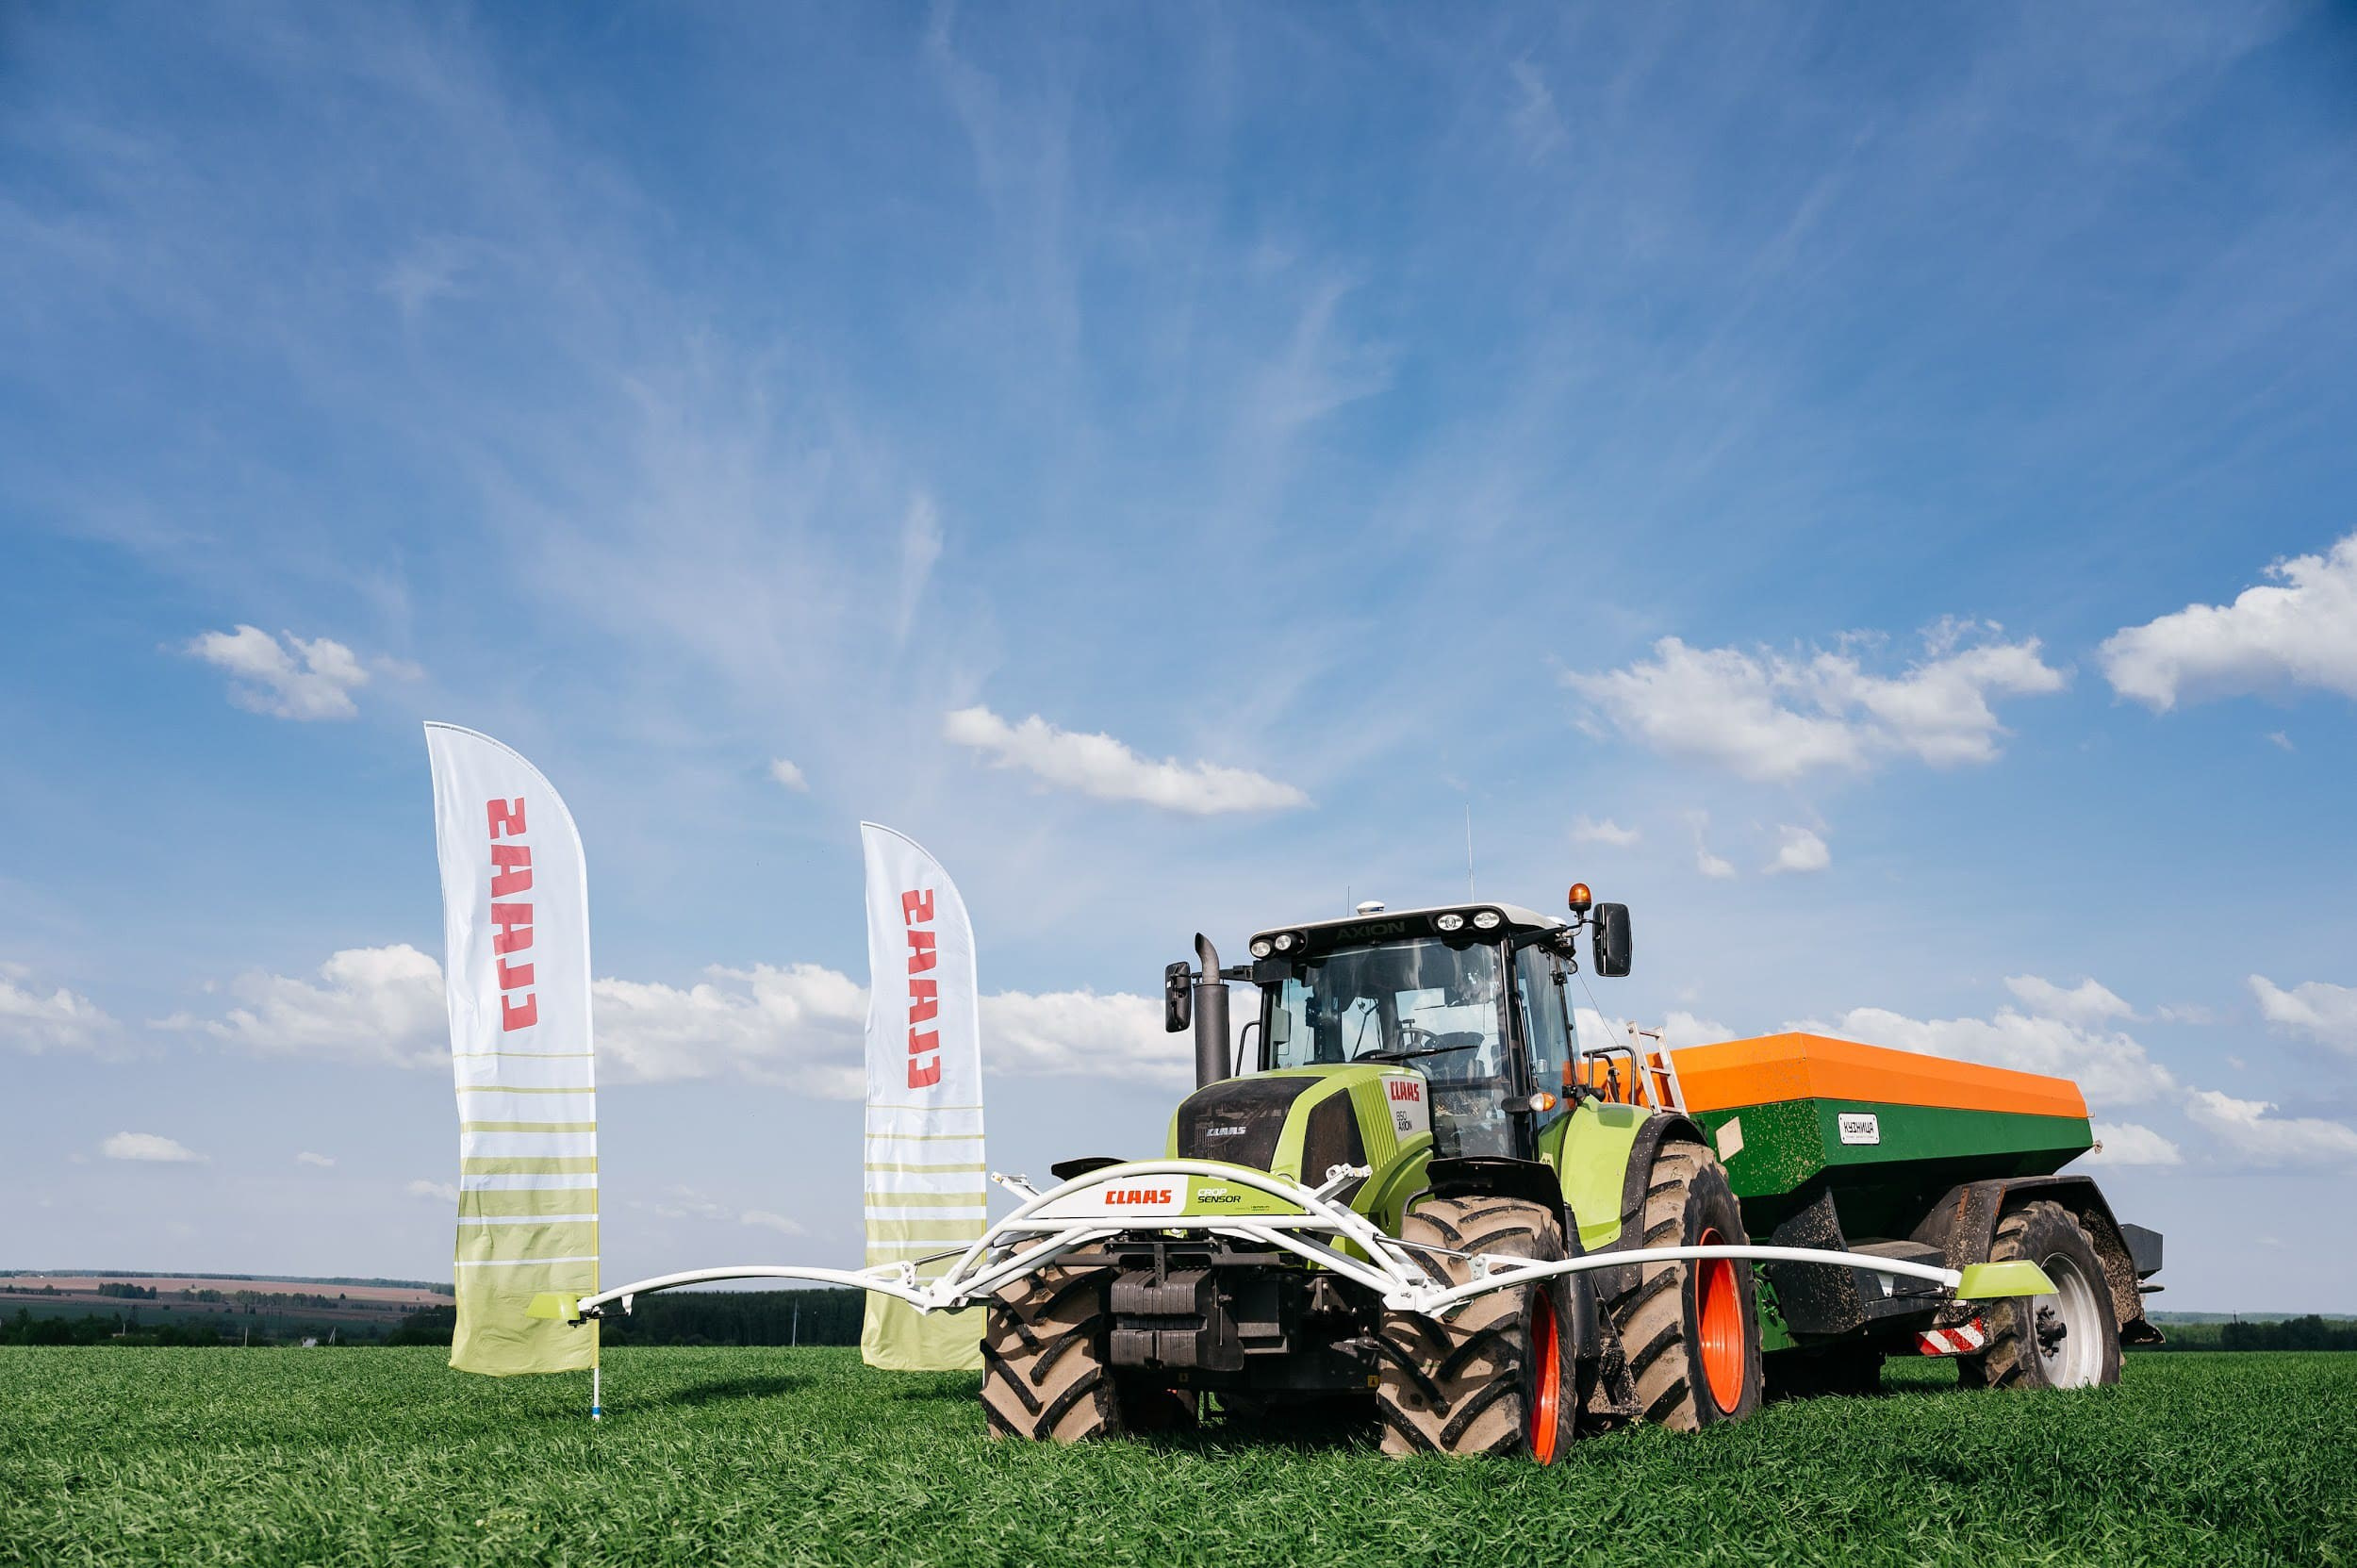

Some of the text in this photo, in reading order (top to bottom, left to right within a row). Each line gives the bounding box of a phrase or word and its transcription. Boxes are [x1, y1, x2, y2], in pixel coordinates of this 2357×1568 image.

[1337, 921, 1405, 940] AXION
[1390, 1081, 1420, 1101] CLAAS
[1207, 1127, 1246, 1136] CLAAS
[1397, 1120, 1412, 1131] AXION
[1844, 1121, 1873, 1133] КУЗНИЦА
[1105, 1190, 1171, 1204] CLAAS
[1197, 1188, 1228, 1197] CROP
